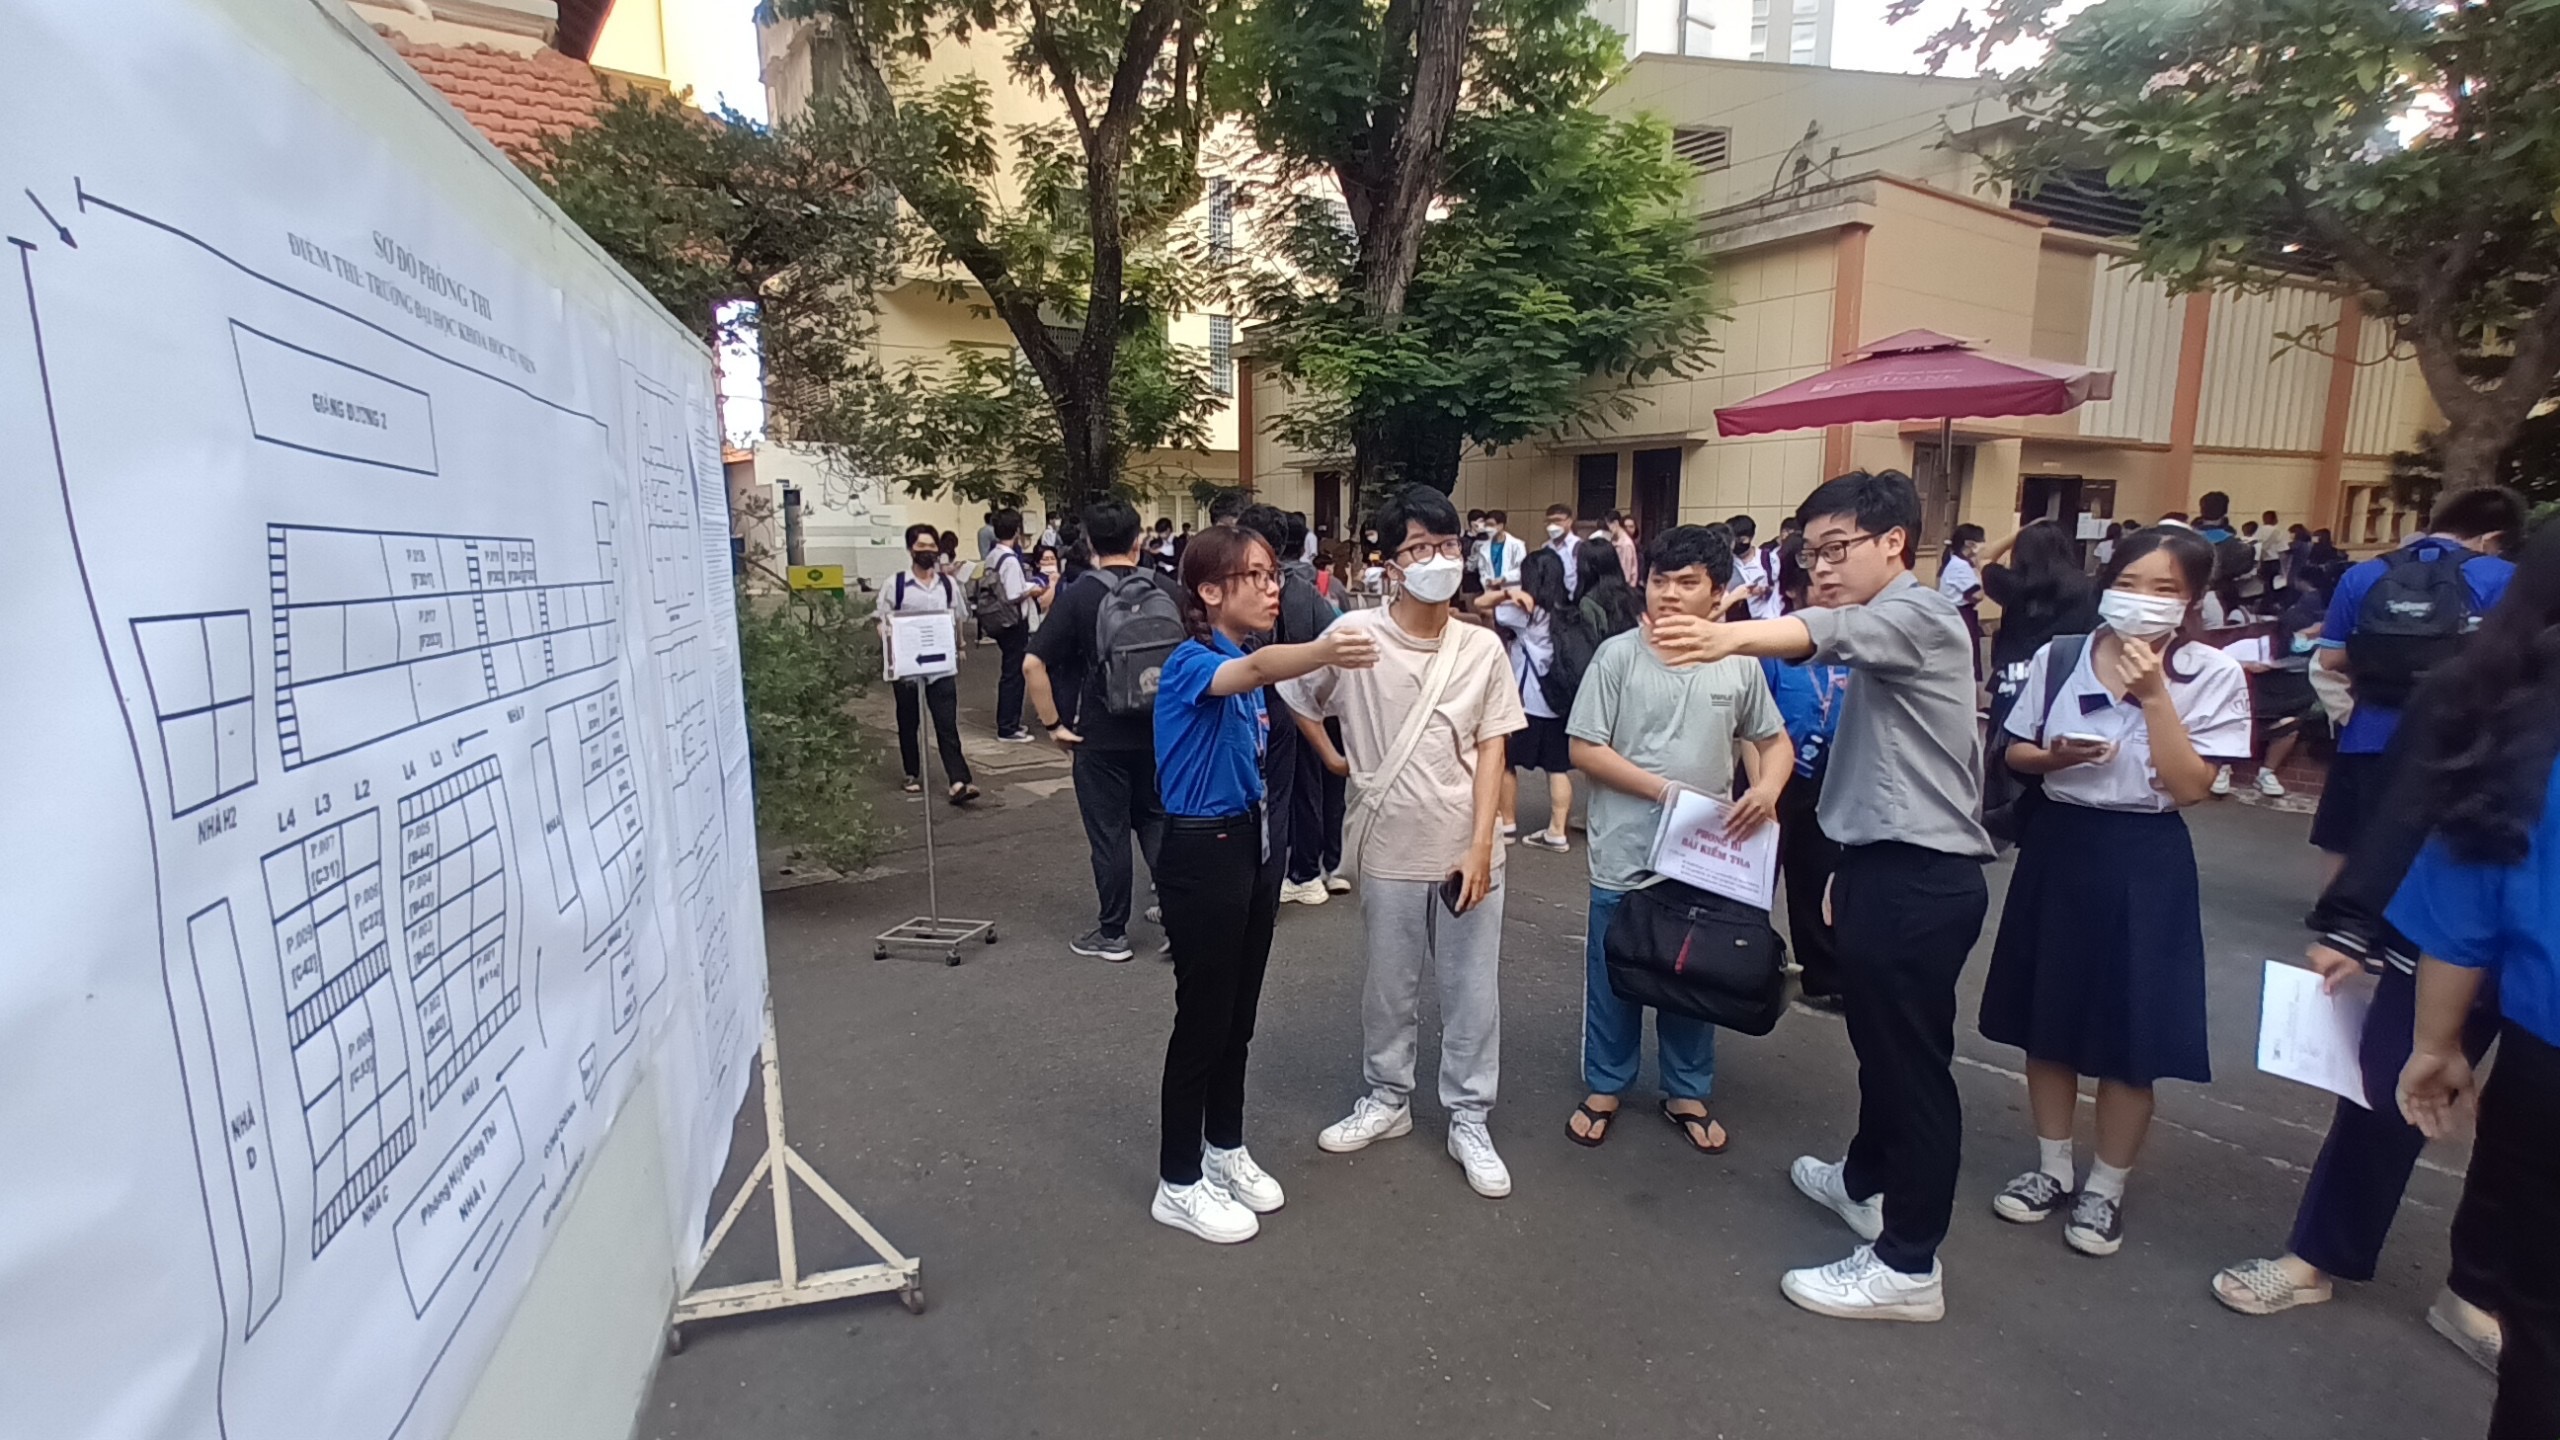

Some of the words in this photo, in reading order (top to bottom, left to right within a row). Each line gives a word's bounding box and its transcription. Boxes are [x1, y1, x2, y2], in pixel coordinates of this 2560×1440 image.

[469, 289, 493, 321] THI
[380, 412, 388, 430] 2
[277, 808, 296, 833] L4
[315, 793, 332, 816] L3
[354, 779, 371, 801] L2
[246, 1146, 257, 1170] D
